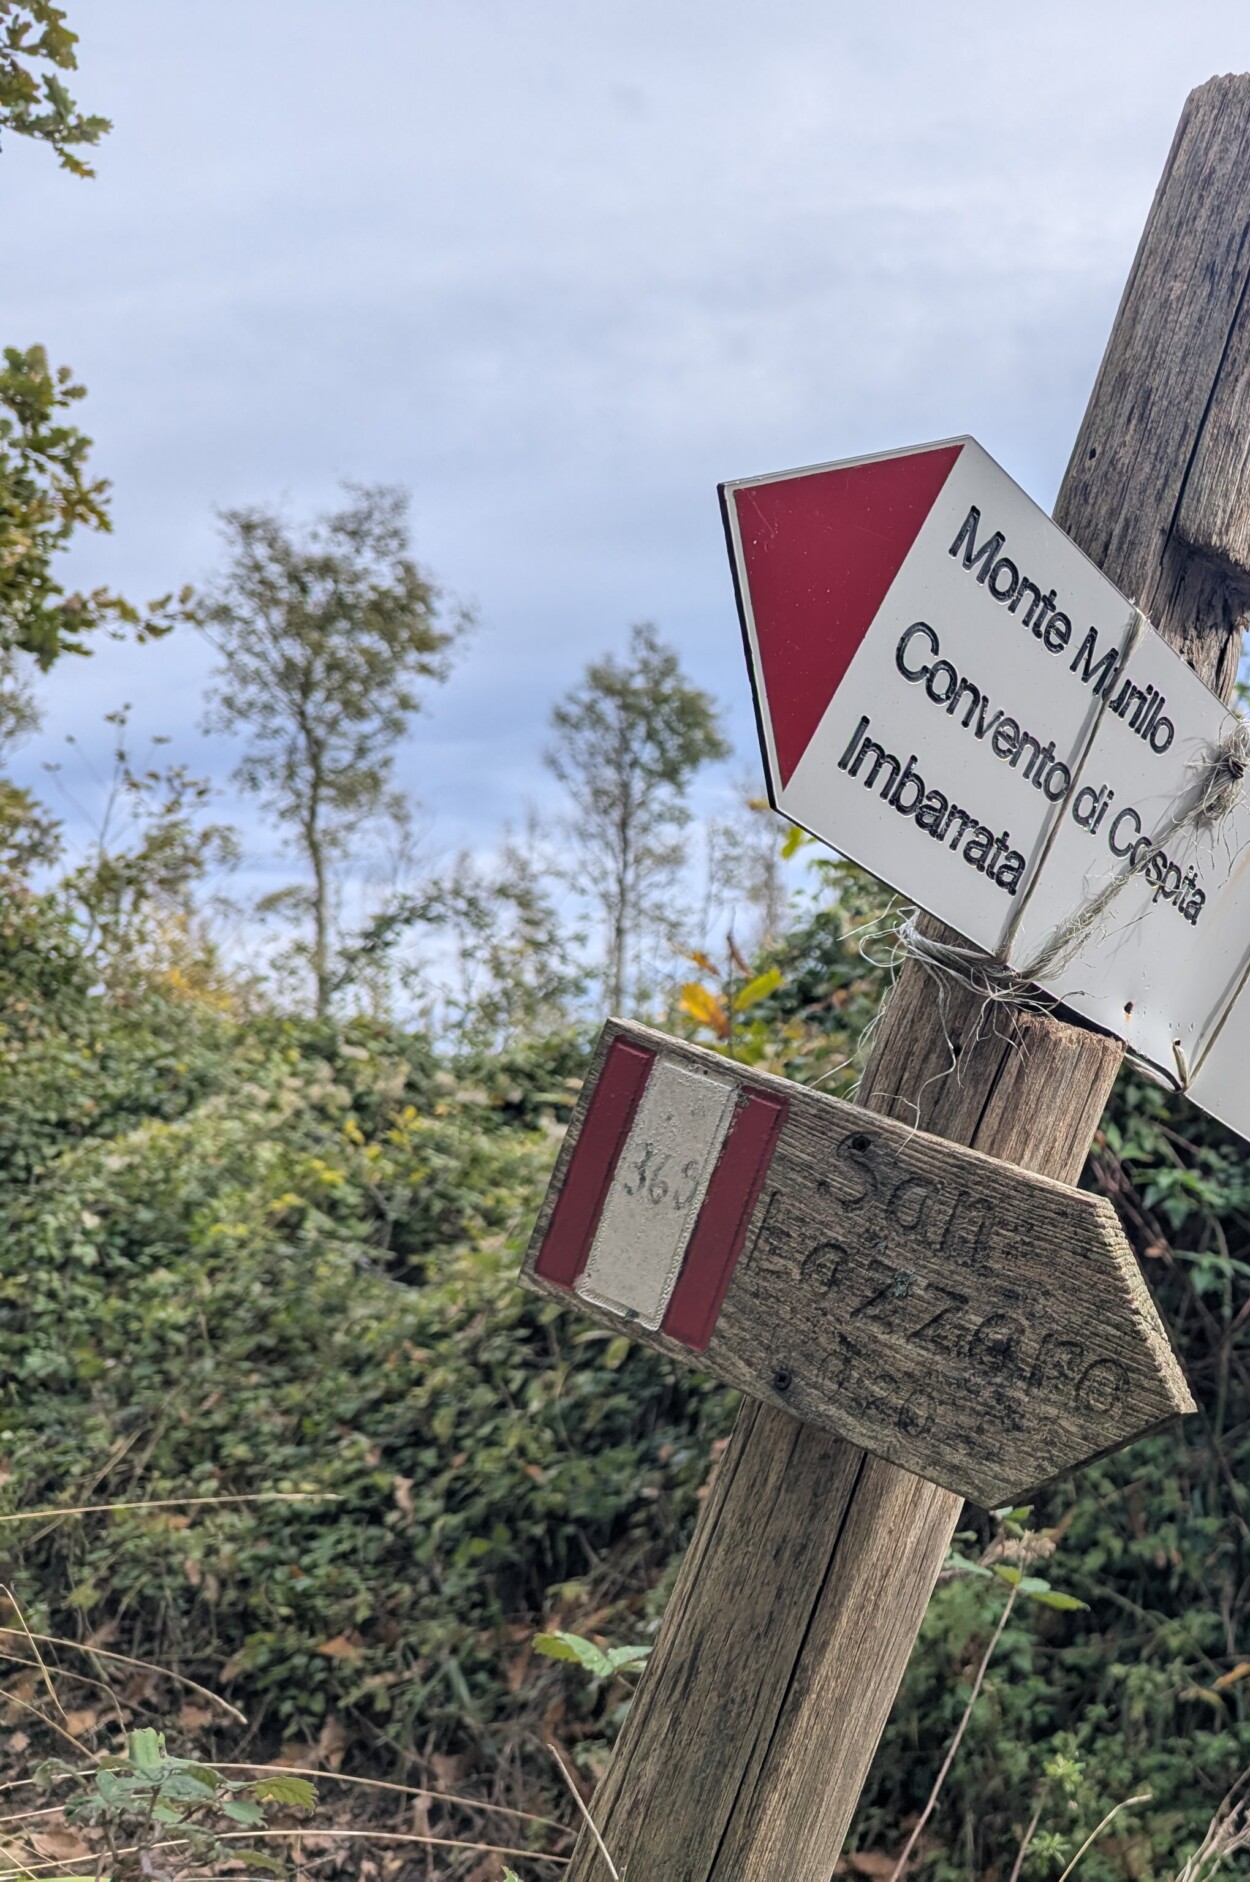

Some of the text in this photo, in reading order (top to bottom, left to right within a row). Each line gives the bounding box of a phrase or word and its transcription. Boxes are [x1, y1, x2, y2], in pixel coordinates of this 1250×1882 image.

[948, 505, 1073, 655] Monte
[837, 715, 1027, 896] Imbarrata
[895, 621, 1206, 926] Convento di Cospita
[818, 1130, 995, 1266] San
